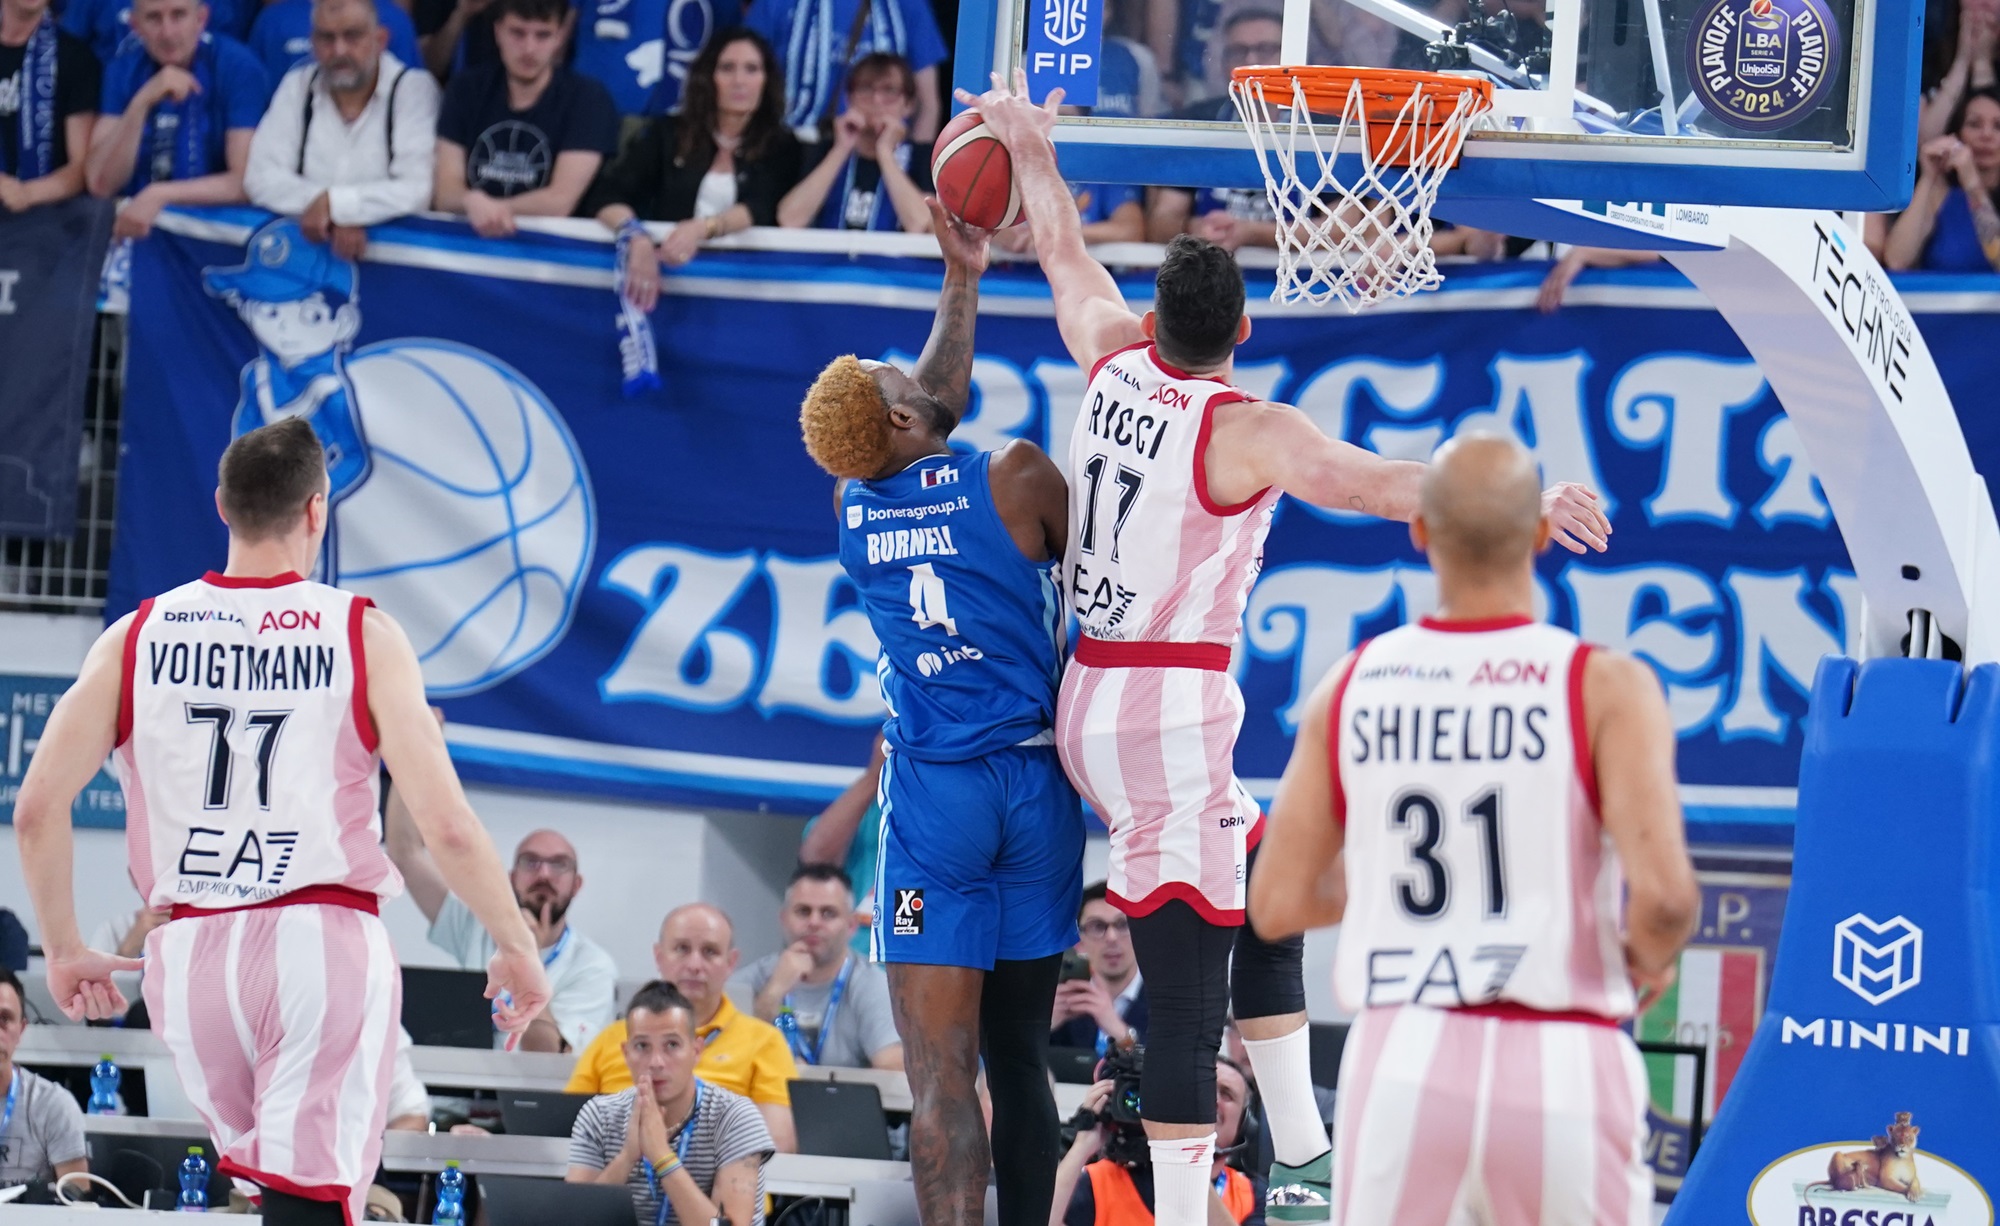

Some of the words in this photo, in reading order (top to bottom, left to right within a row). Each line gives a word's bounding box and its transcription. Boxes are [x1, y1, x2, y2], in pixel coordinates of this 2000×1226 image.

[1703, 5, 1737, 92] PLAYOFF
[1745, 33, 1782, 48] LBA
[1791, 9, 1823, 98] PLAYOFF
[1034, 52, 1092, 75] FIP
[1741, 63, 1780, 77] UnipolSai
[1729, 88, 1785, 113] 2024
[1610, 210, 1625, 222] CREDITO
[1675, 208, 1709, 225] LOMBARDO
[1813, 220, 1910, 404] TECHNE
[1864, 269, 1913, 347] METROLOGIA
[1149, 384, 1193, 411] AON
[1088, 390, 1169, 460] RICCI
[867, 496, 970, 521] boneragroup.it
[1080, 453, 1145, 563] 17
[867, 525, 959, 565] BURNELL
[906, 562, 959, 637] 4
[163, 610, 246, 628] DRIVALIA
[258, 609, 321, 635] AON
[150, 641, 334, 691] VOIGTMANN
[1469, 660, 1549, 687] AON
[1352, 704, 1549, 764] SHIELDS
[184, 702, 295, 811] 77
[179, 827, 299, 884] EA7
[1386, 783, 1509, 922] 31
[895, 890, 916, 916] X
[895, 916, 914, 927] Ray
[1781, 1016, 1970, 1056] MININI
